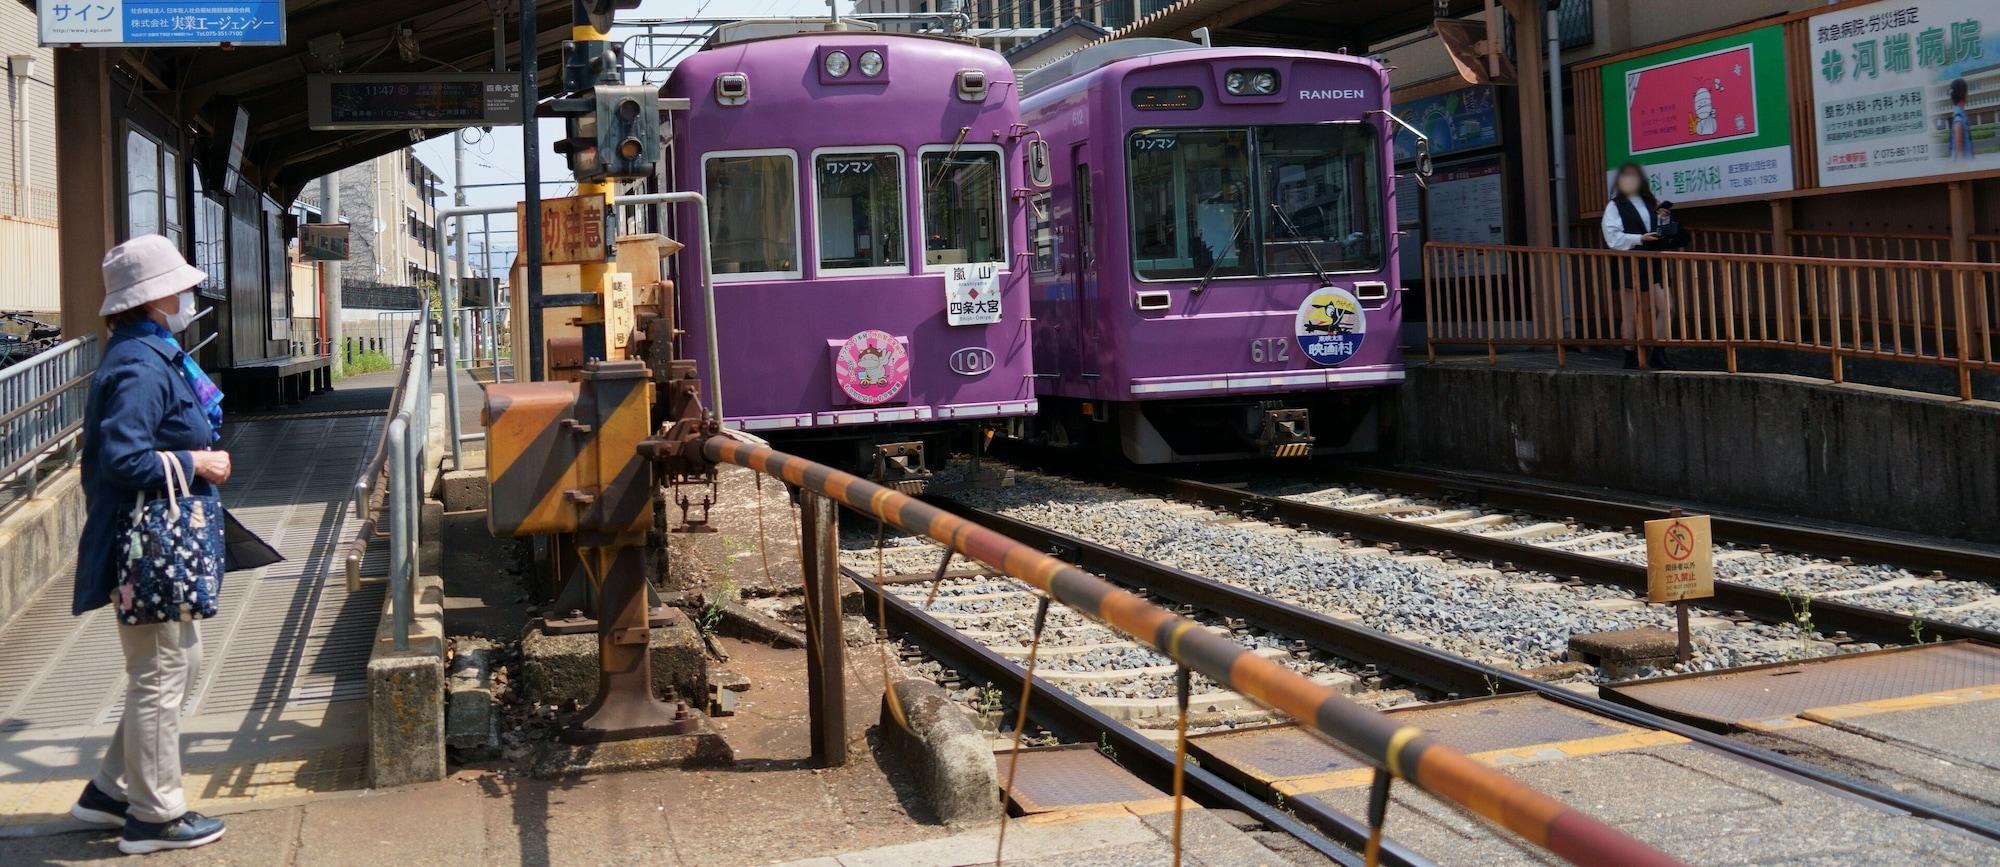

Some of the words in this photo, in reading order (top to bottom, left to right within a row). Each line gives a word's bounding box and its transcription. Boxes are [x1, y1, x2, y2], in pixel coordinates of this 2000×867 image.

[52, 4, 115, 22] サイン
[131, 19, 169, 28] 株式会社
[171, 16, 275, 31] 実業エージェンシー
[1851, 18, 1984, 80] 河端病院
[365, 85, 394, 96] 11:47
[486, 84, 520, 93] 四条大宮
[1300, 89, 1365, 100] RANDEN
[1824, 91, 1921, 119] 整形外科・内科・外科
[1135, 138, 1176, 151] ワンマン
[826, 162, 873, 174] ワンマン
[521, 208, 602, 250] 切注意
[950, 299, 999, 315] 四条大宮
[1251, 339, 1289, 363] 612
[1308, 342, 1353, 357] 映画村
[957, 351, 987, 371] 101
[1665, 561, 1696, 571] 関係者以外
[1665, 573, 1696, 584] 立入禁止
